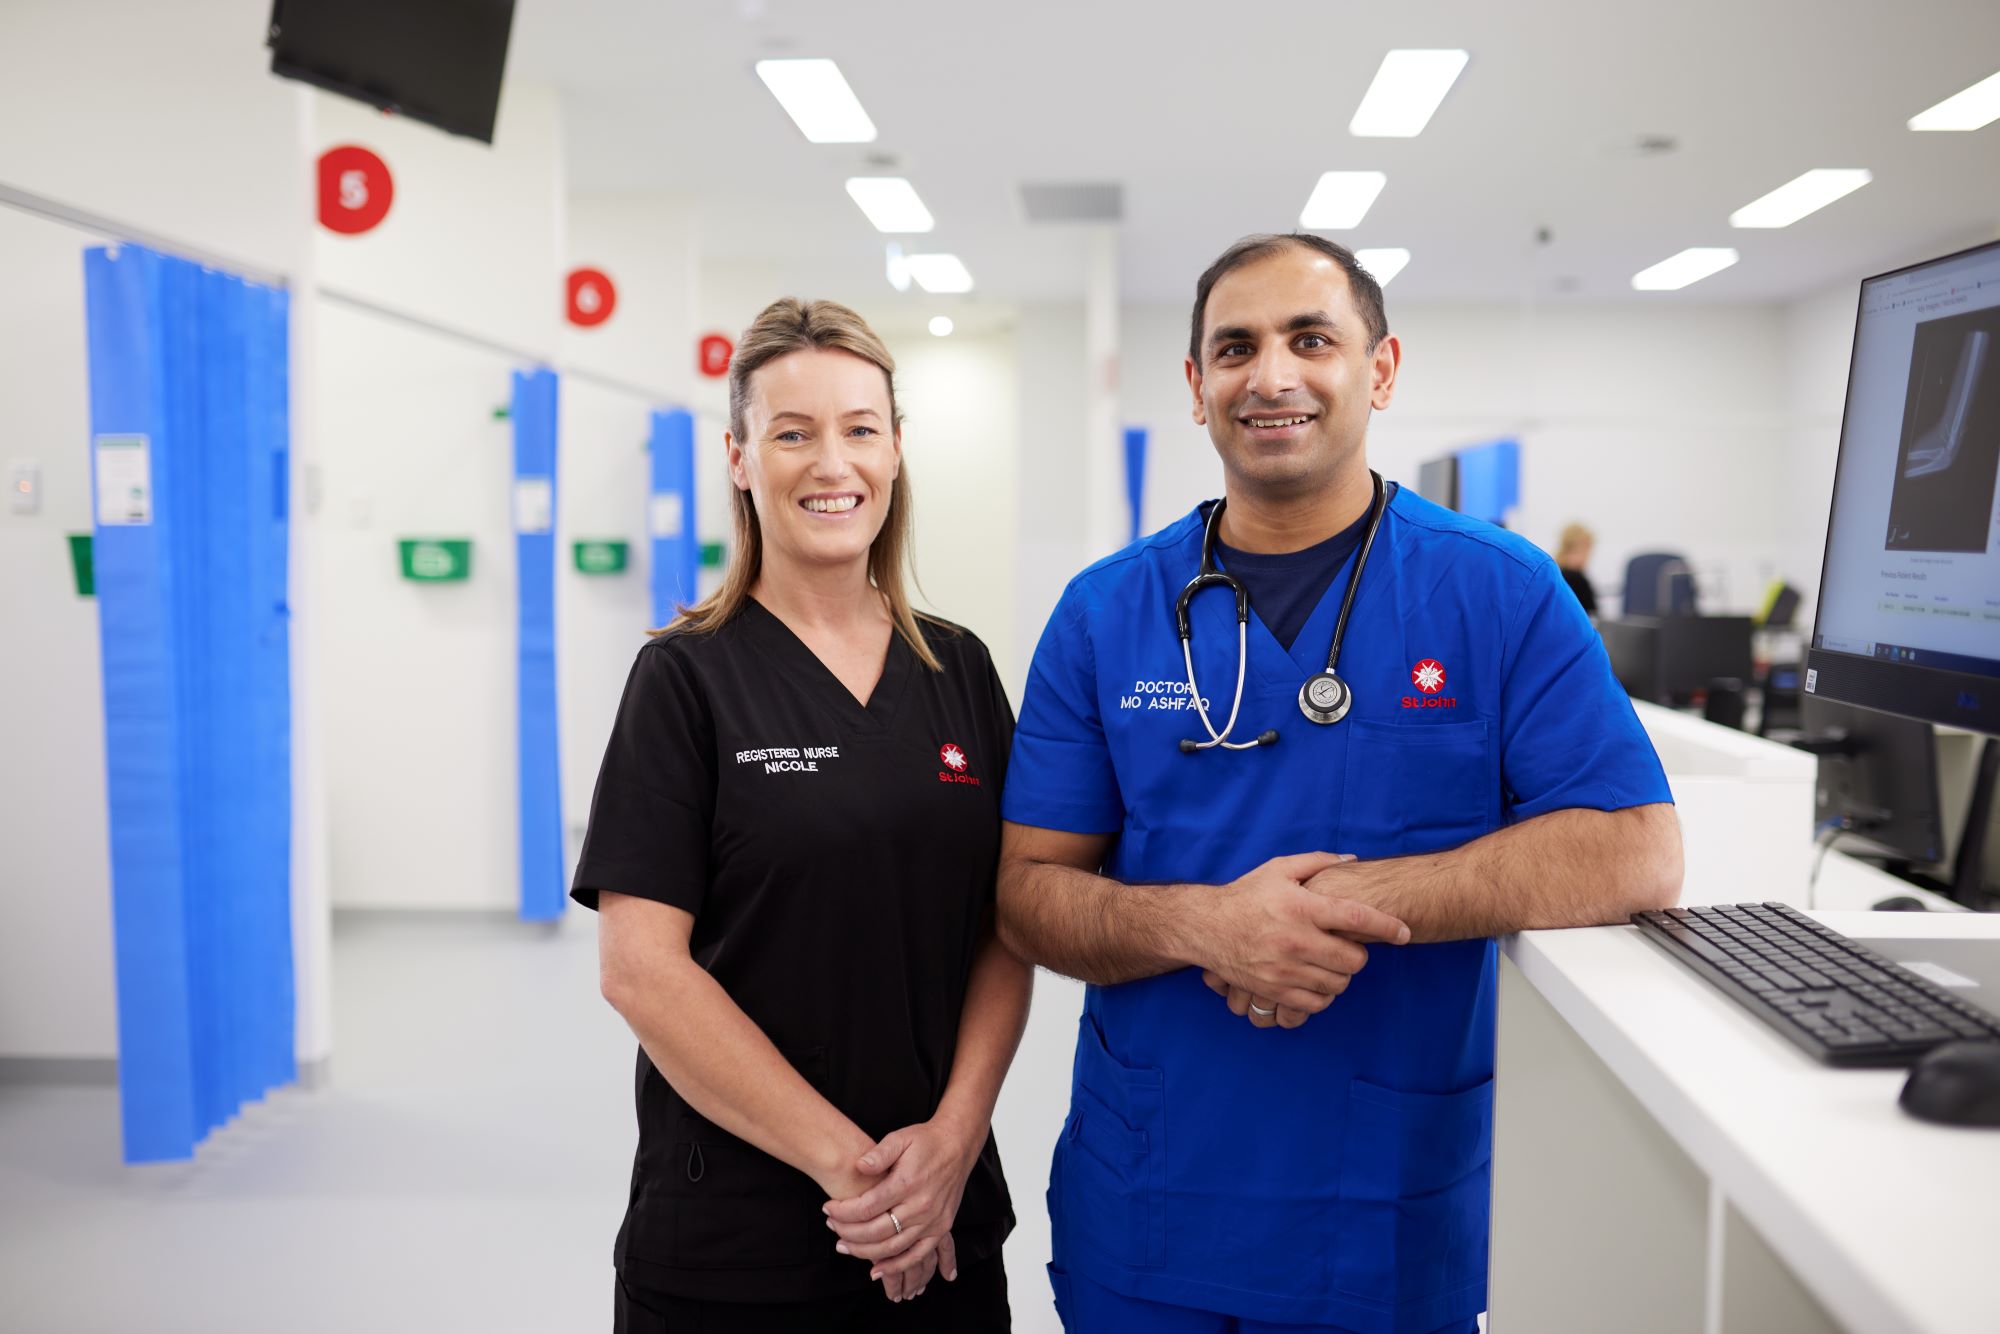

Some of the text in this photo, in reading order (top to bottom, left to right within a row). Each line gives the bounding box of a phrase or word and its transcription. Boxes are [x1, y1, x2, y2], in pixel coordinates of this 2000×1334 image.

[339, 170, 369, 210] 5
[1135, 681, 1192, 694] DOCTOR
[1120, 696, 1210, 711] MO ASHFAQ
[1401, 696, 1457, 709] St John
[736, 747, 839, 763] REGISTERED NURSE
[764, 760, 818, 774] NICOLE
